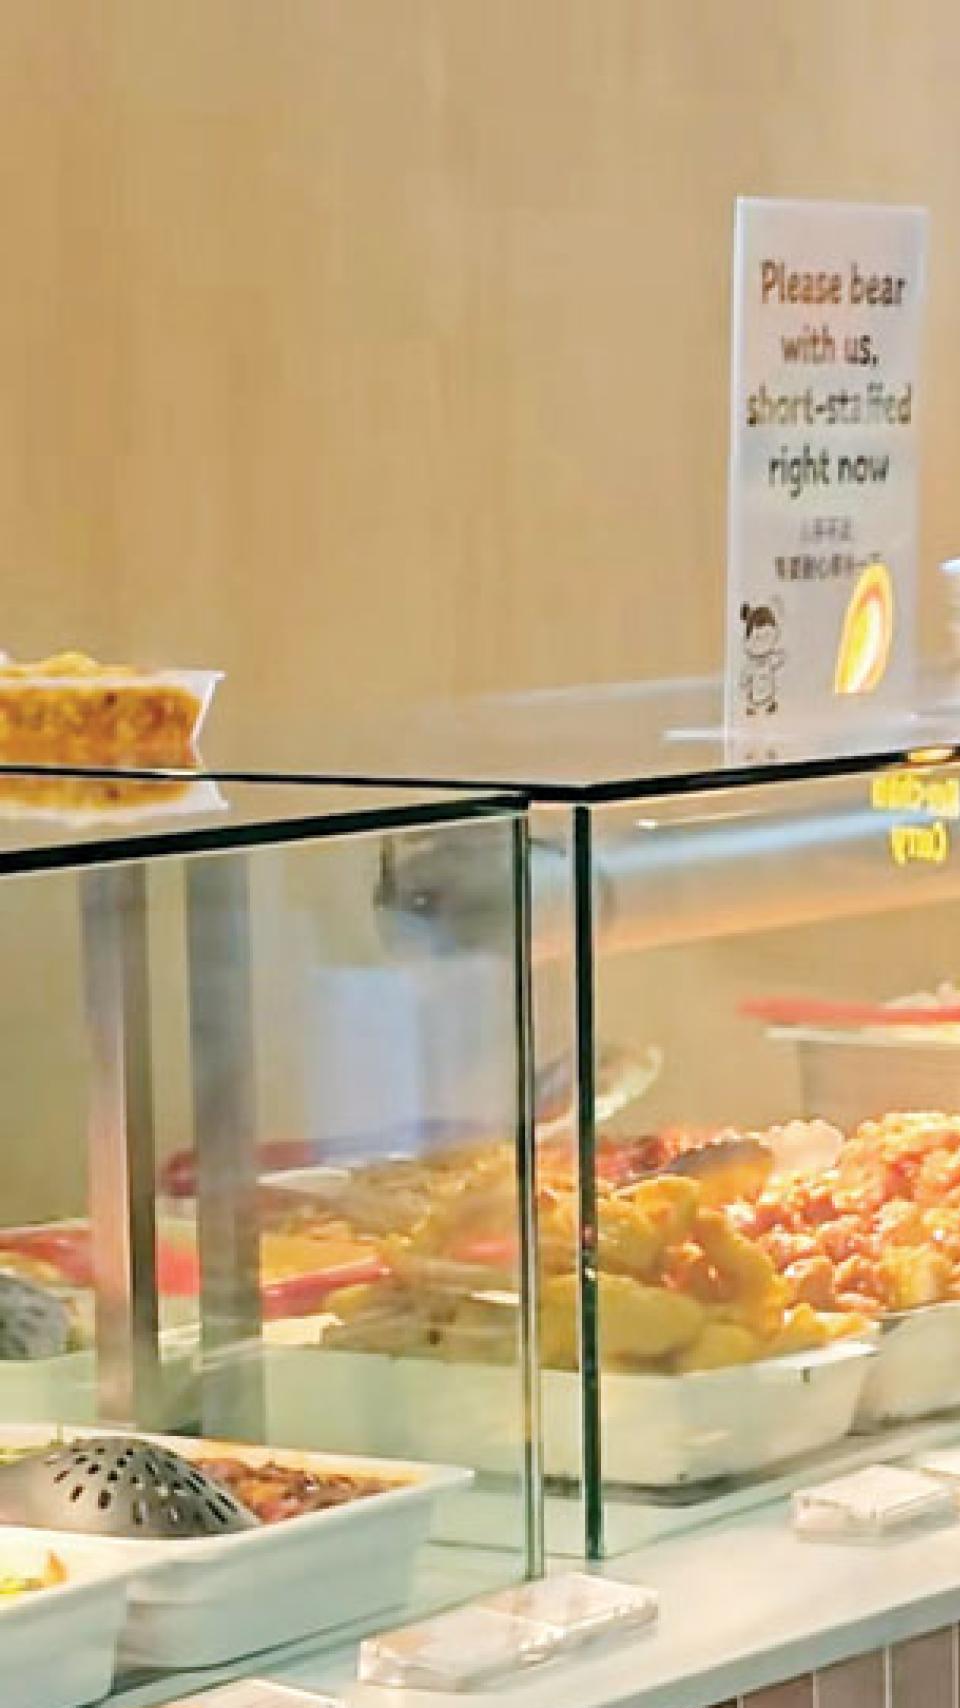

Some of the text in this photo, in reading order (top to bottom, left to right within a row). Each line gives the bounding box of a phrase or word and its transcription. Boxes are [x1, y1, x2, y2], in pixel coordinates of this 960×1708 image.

[760, 259, 906, 305] Please bear
[781, 322, 878, 367] with us,
[746, 381, 911, 427] short-staffed
[768, 443, 889, 499] right now
